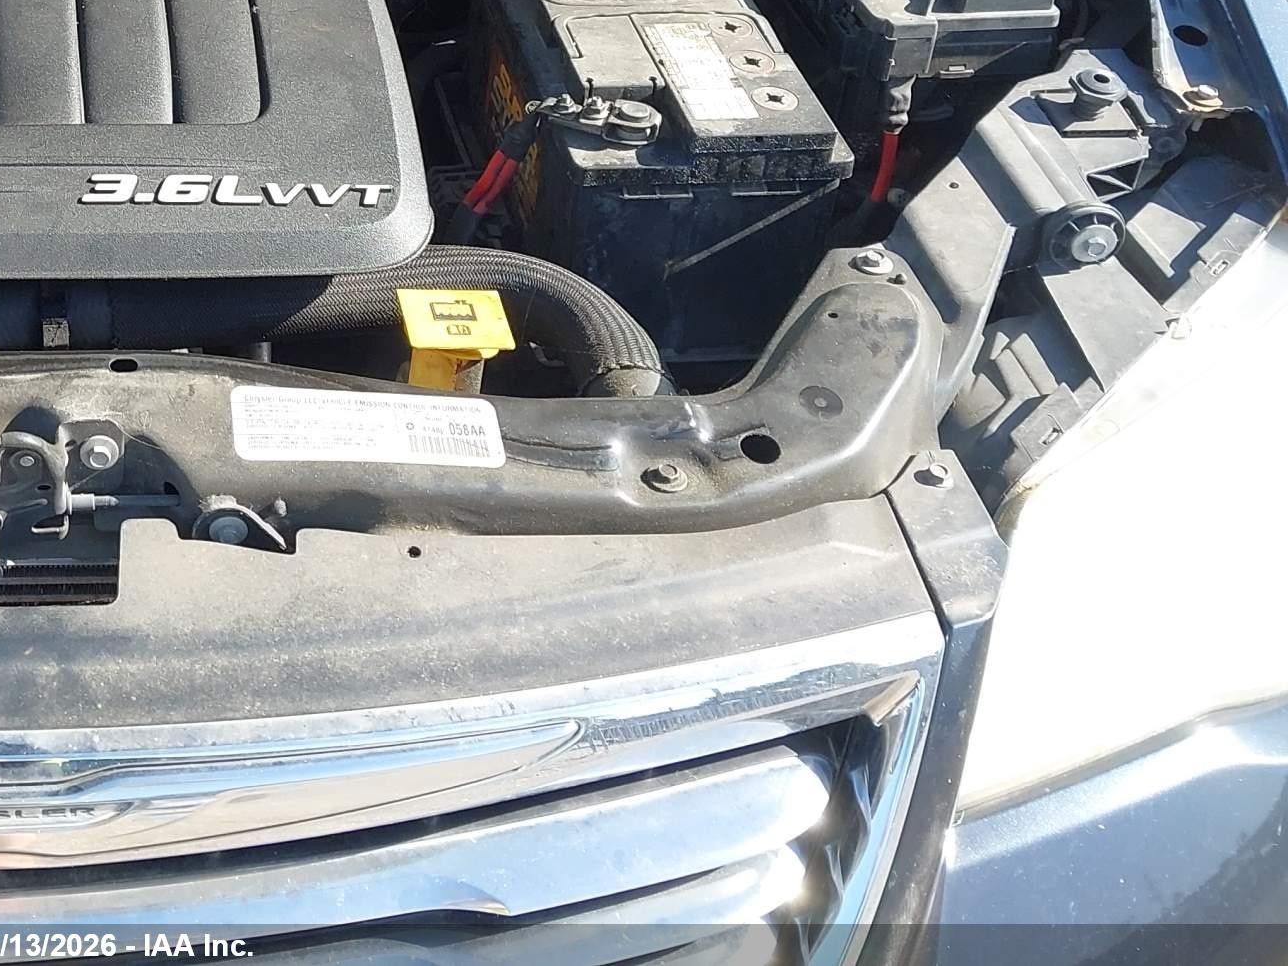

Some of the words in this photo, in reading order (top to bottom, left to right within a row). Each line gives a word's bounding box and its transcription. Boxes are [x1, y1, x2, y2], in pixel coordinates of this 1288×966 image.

[78, 172, 264, 206] 3.6L
[260, 182, 393, 207] VVT
[448, 422, 486, 436] 058AA
